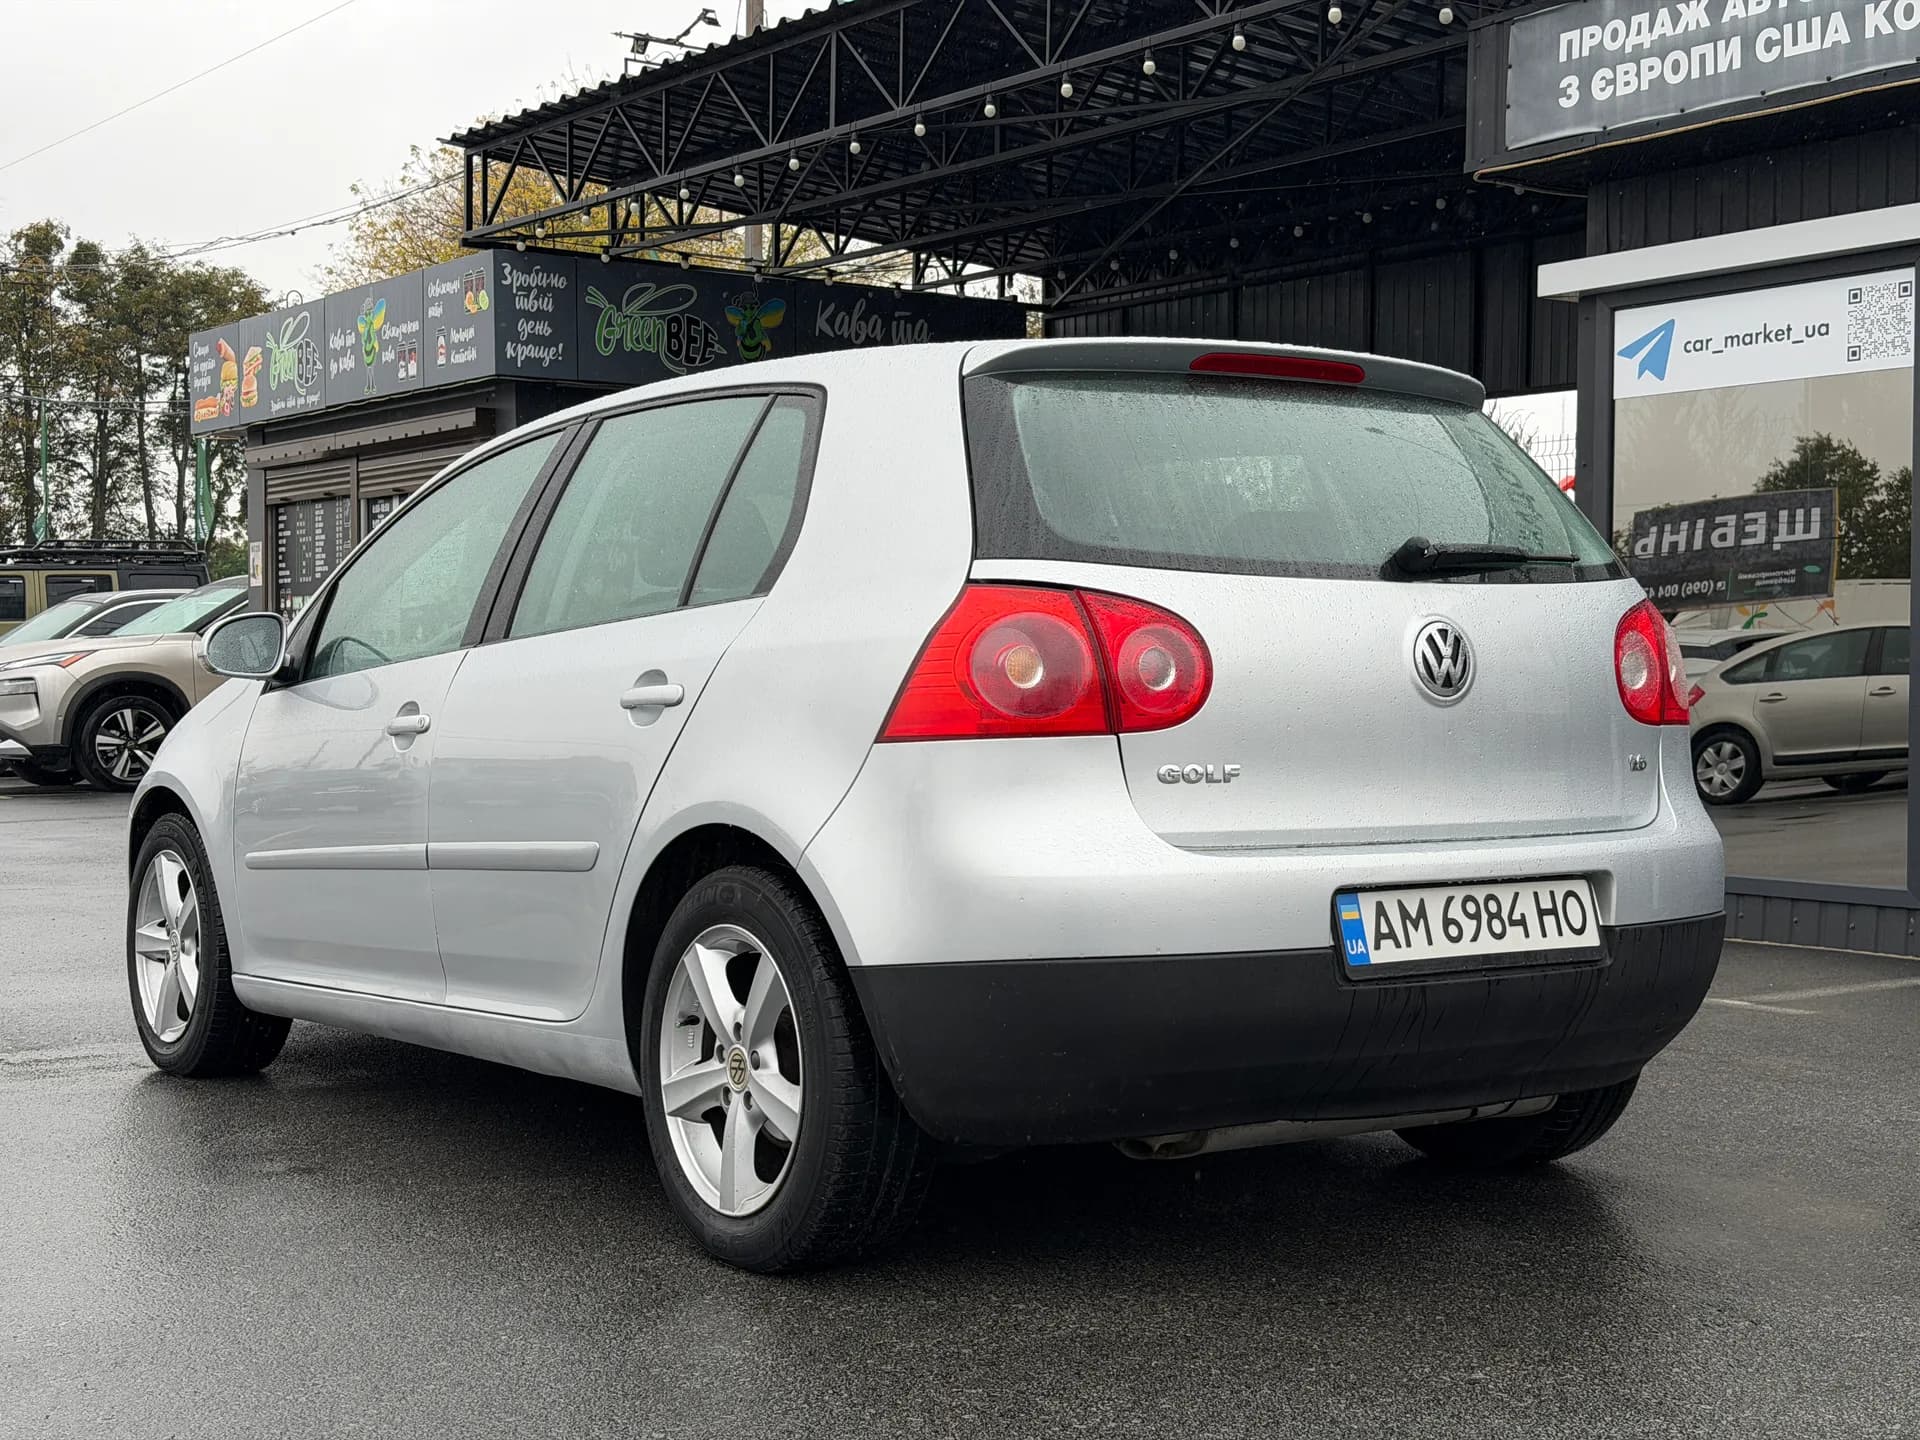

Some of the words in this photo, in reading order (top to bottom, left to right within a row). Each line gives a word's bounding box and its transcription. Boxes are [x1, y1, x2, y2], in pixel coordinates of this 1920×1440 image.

[1558, 0, 1711, 63] ПРОДАЖ
[1558, 75, 1580, 108] З
[1590, 36, 1742, 98] ЄВРОПИ
[1755, 11, 1851, 63] США
[501, 262, 568, 294] Зробимо
[515, 289, 554, 313] твій
[517, 318, 553, 341] день
[815, 298, 887, 345] Кава
[1683, 321, 1830, 354] car_market_ua
[504, 341, 564, 368] краще!
[1157, 763, 1241, 784] GOLF
[1373, 897, 1433, 950] AM
[1441, 891, 1530, 943] 6984
[1346, 939, 1367, 955] UA
